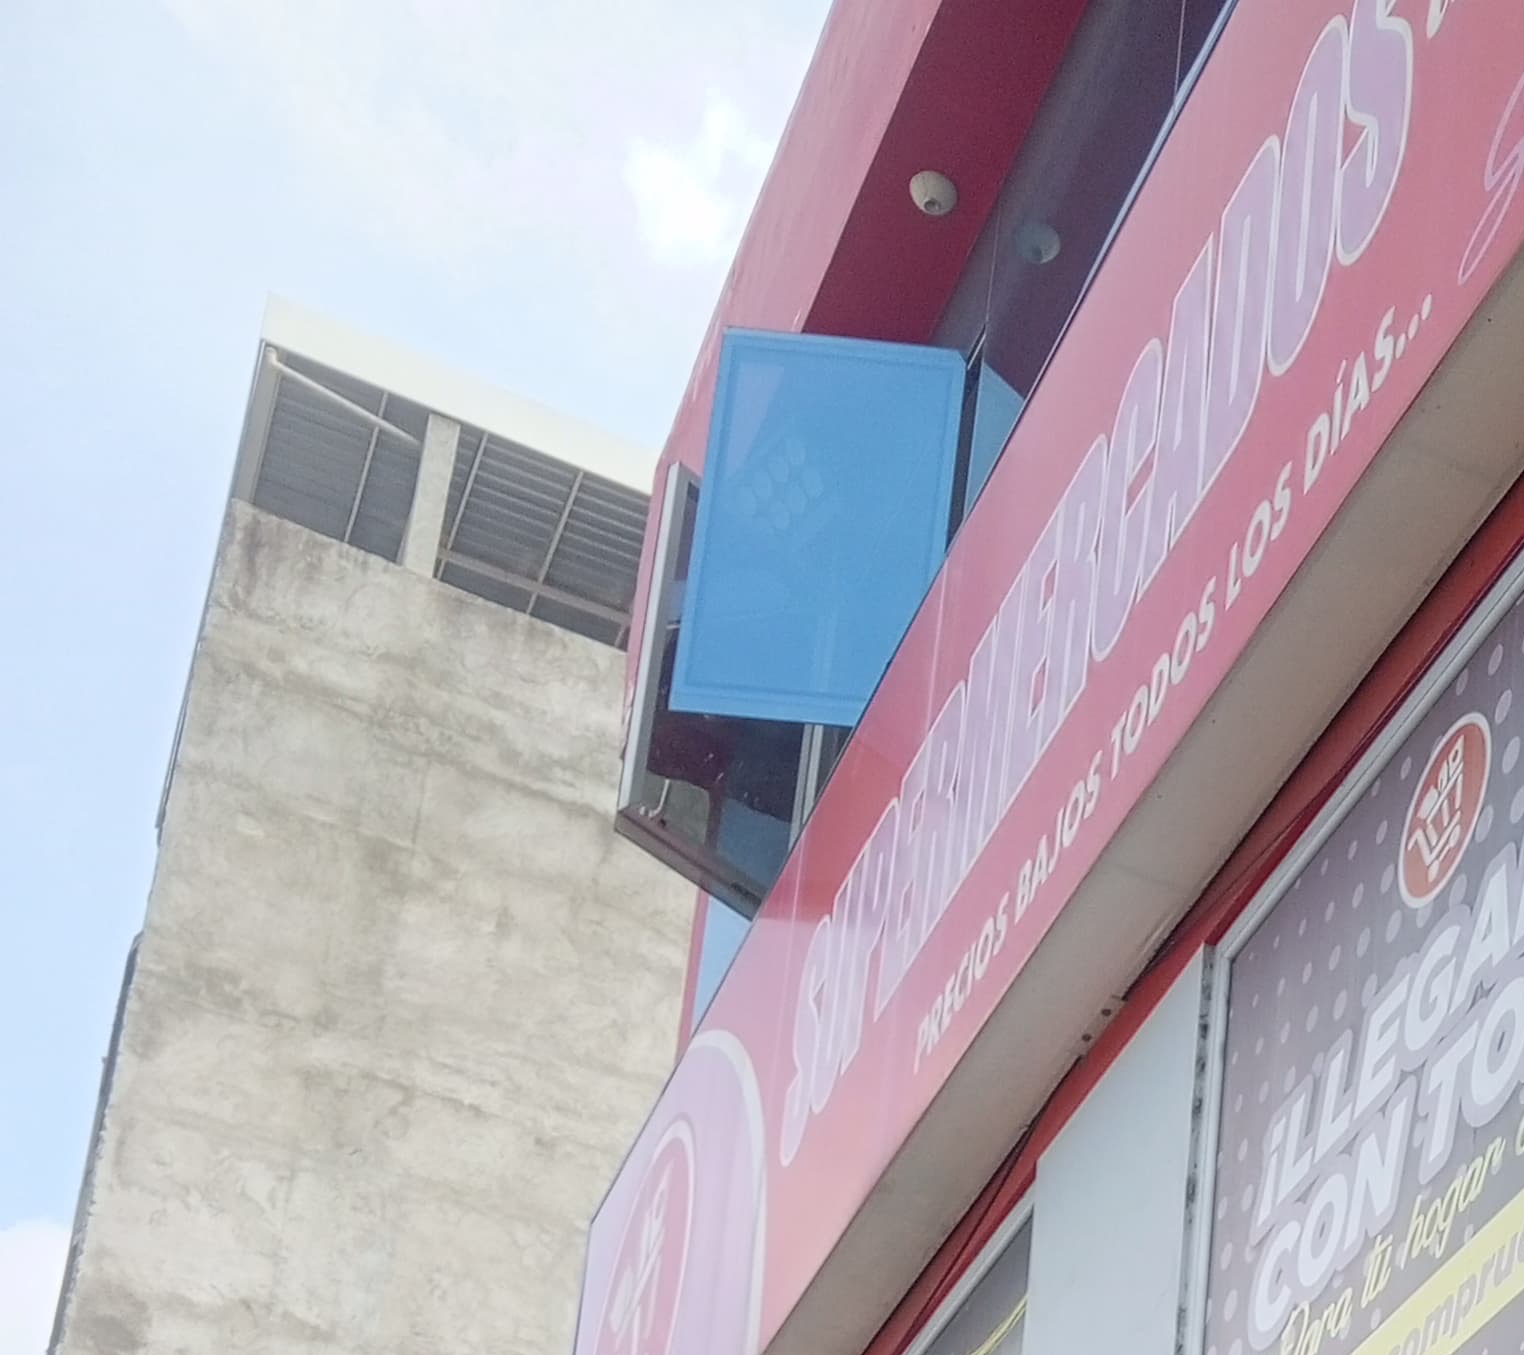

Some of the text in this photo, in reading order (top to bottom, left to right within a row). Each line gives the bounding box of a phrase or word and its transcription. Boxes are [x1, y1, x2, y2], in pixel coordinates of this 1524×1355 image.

[779, 0, 1413, 1167] SUPERMERCADOS
[914, 894, 1010, 1075] PRECIOS
[1014, 751, 1103, 925] BAJOS
[1111, 576, 1216, 780] TODOS
[1226, 461, 1293, 611] LOS
[1254, 1095, 1410, 1334] CON
[1359, 1233, 1393, 1309] tu
[1400, 1136, 1506, 1270] hogar
